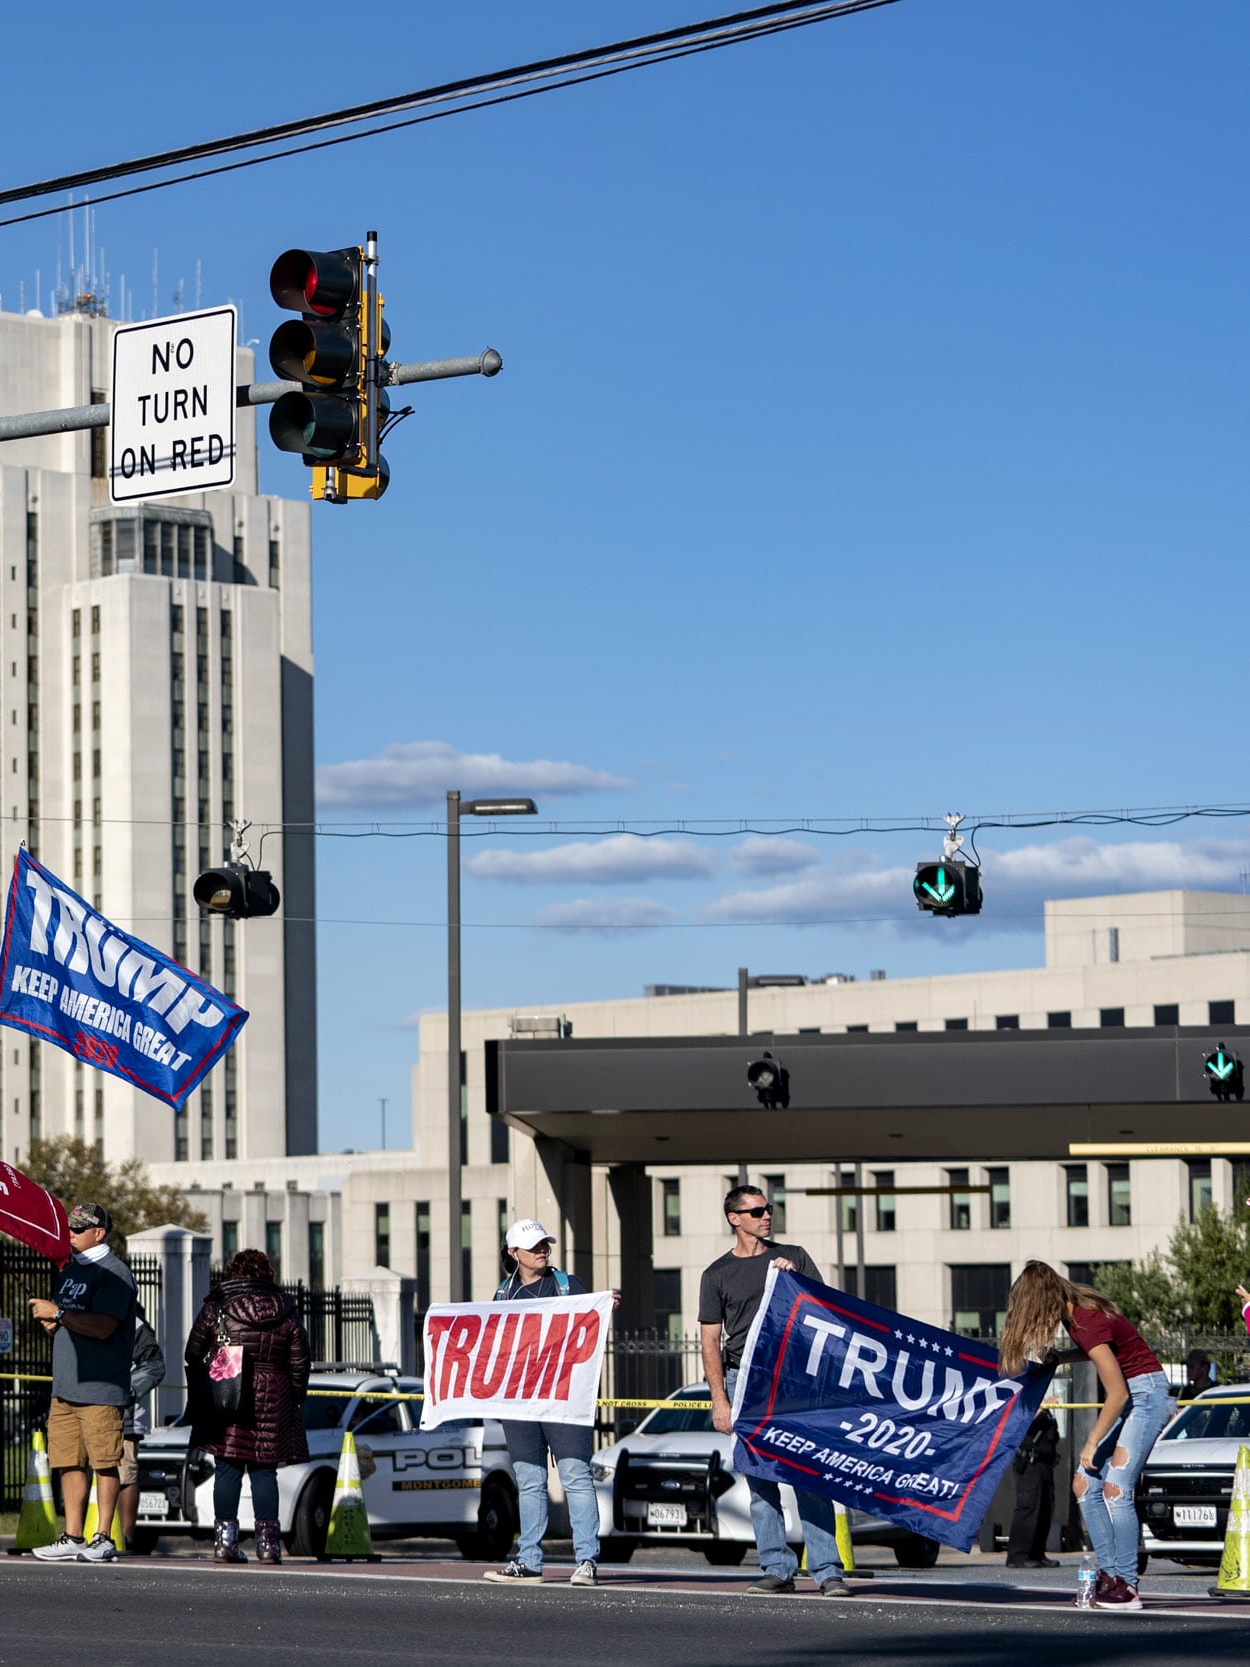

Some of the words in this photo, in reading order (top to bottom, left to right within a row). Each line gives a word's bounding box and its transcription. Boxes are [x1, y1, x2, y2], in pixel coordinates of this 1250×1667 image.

[152, 338, 194, 375] NO
[138, 385, 207, 426] TURN
[121, 444, 155, 479] ON
[172, 434, 224, 472] RED
[26, 869, 225, 1035] TRUMP
[11, 964, 58, 1003] KEEP
[59, 985, 131, 1043] AMERICA
[132, 1021, 192, 1071] GREAT
[72, 1031, 119, 1069] 2020
[427, 1308, 600, 1407] TRUMP
[802, 1314, 1024, 1425] TRUMP
[393, 1446, 482, 1471] POL
[762, 1426, 815, 1456] KEEP
[812, 1448, 894, 1485] AMERICA
[895, 1472, 960, 1499] GREAT!
[401, 1479, 482, 1491] MONTGOME
[654, 1508, 680, 1519] 06793
[1182, 1509, 1208, 1520] 11176
